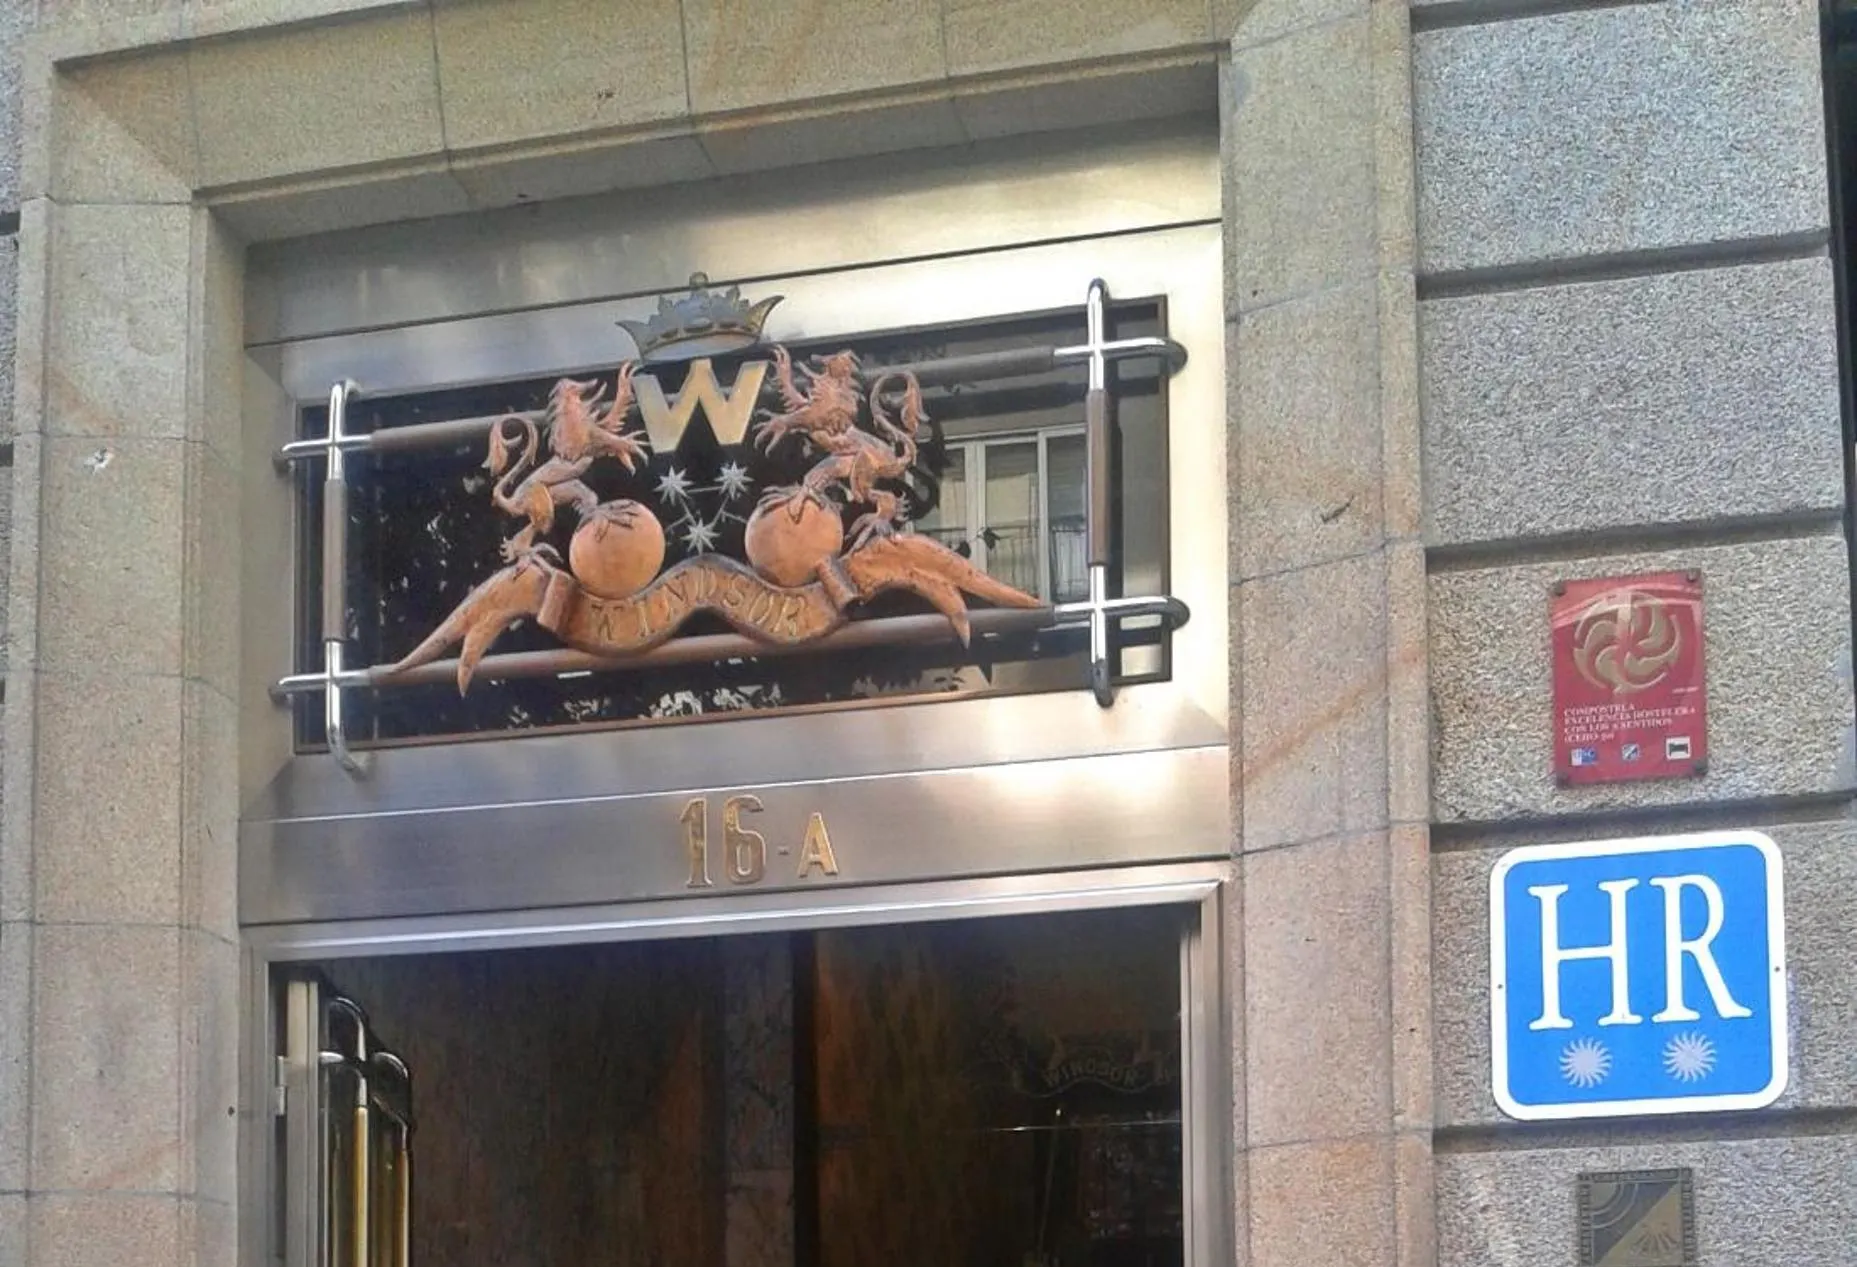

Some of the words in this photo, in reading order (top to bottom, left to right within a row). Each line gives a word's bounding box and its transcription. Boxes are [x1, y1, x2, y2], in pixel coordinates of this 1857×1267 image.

[632, 357, 769, 454] W
[590, 566, 806, 641] WINDSOR
[1528, 874, 1752, 1030] HR
